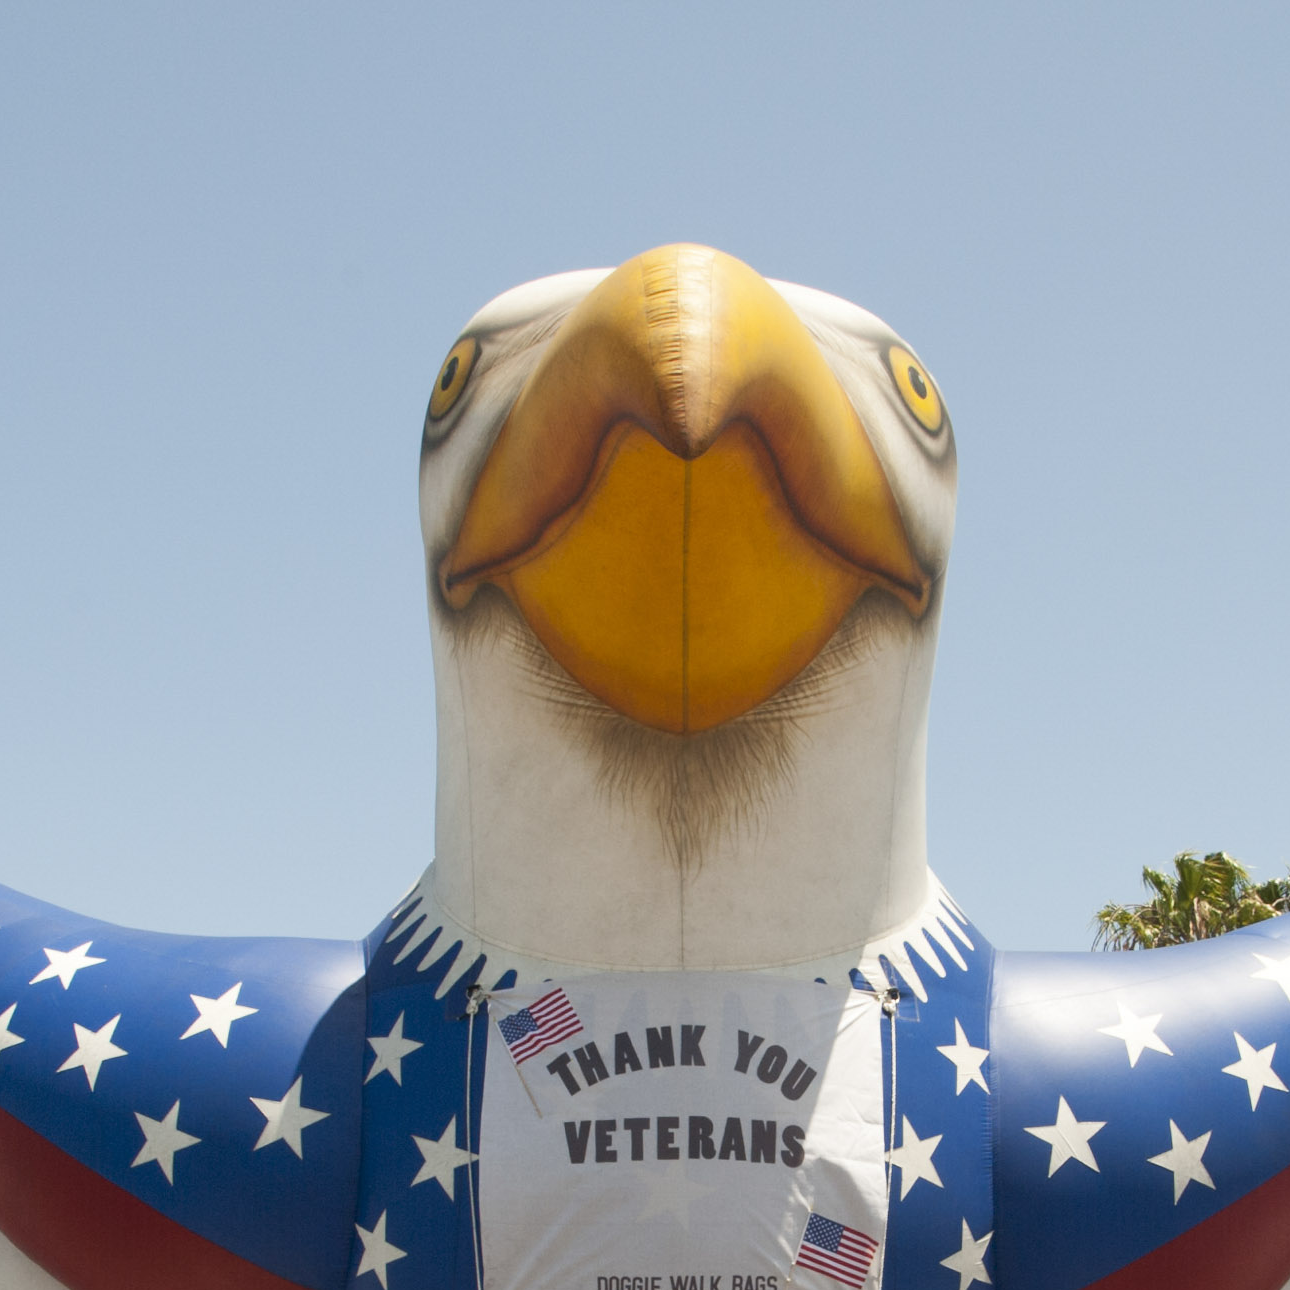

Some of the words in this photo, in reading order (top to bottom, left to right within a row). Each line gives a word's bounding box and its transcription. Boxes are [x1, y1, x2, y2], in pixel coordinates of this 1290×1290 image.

[545, 1024, 707, 1097] THANK
[733, 1029, 818, 1101] YOU
[563, 1115, 806, 1169] VETERANS
